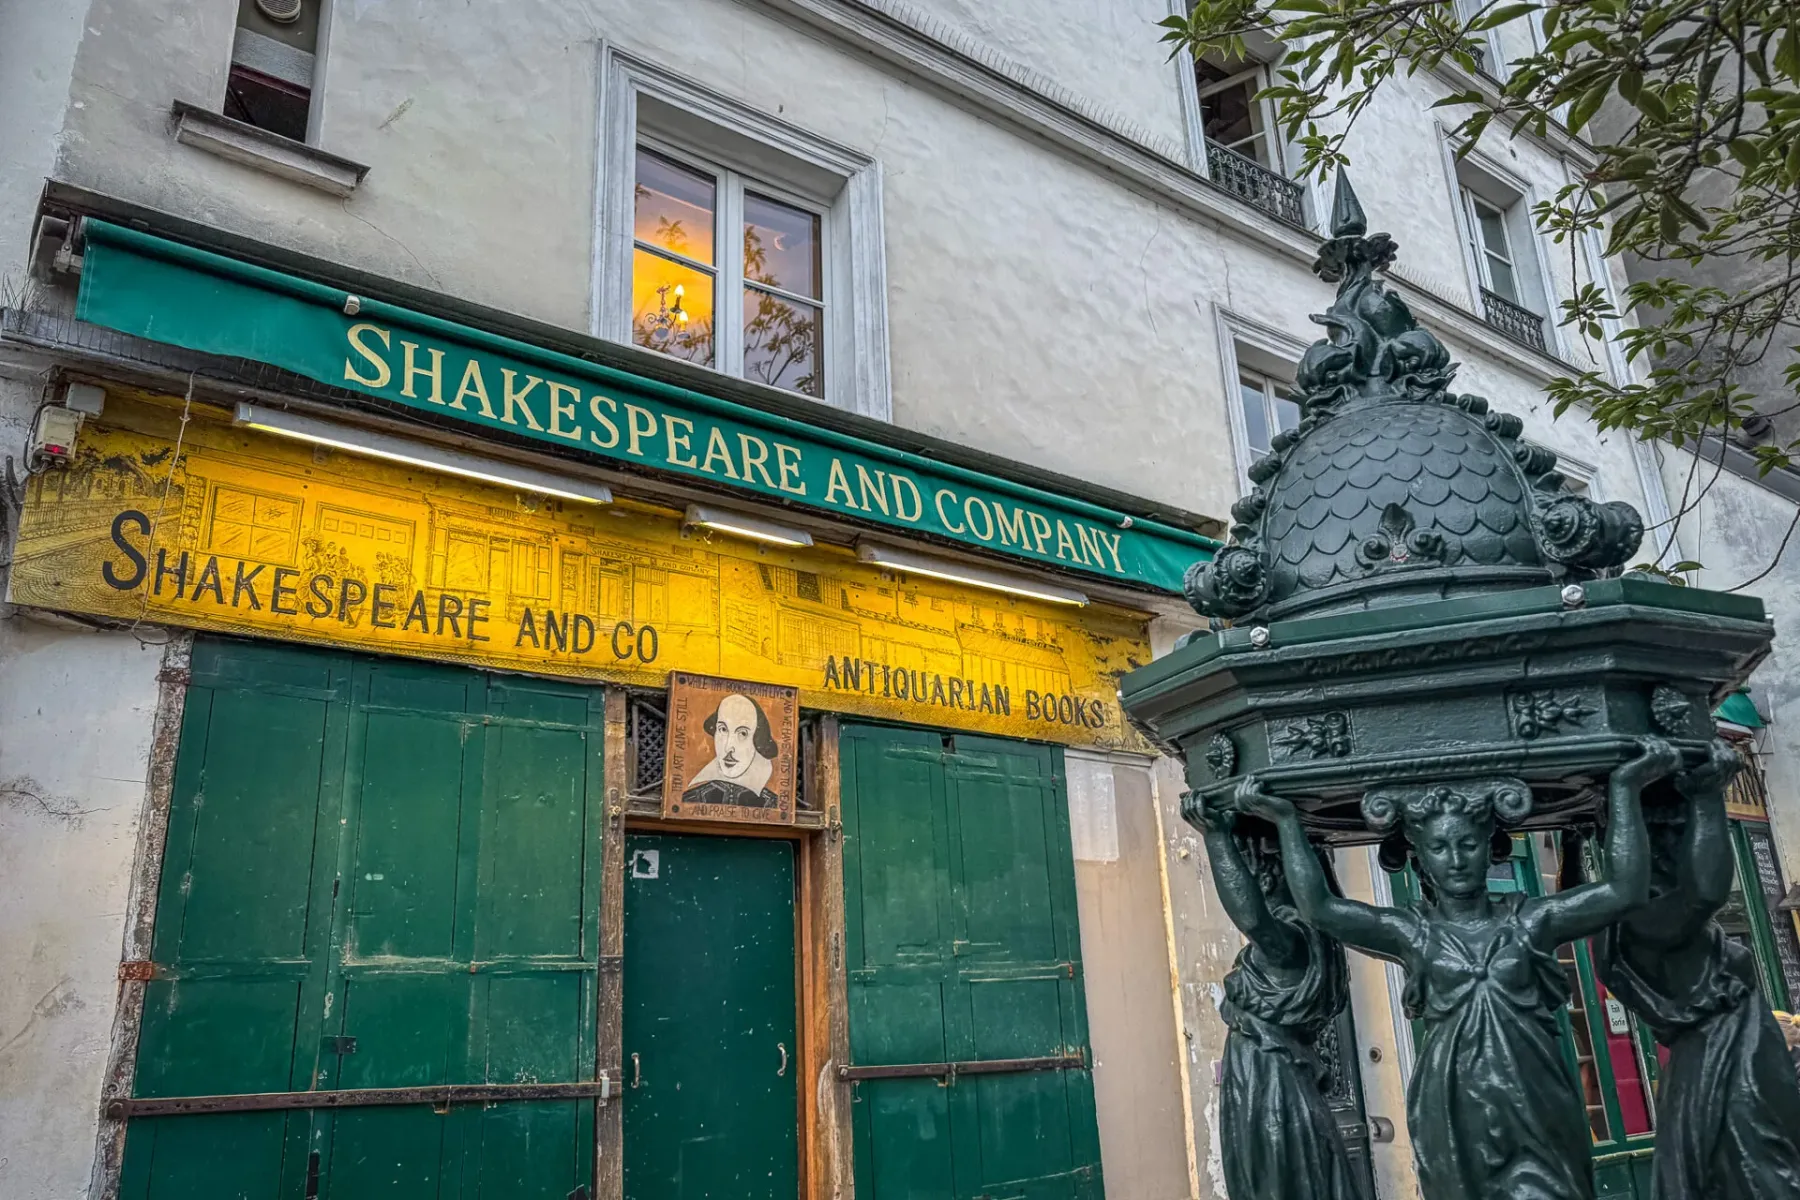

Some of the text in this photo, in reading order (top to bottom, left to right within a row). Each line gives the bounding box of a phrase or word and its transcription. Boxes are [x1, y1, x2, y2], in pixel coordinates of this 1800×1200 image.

[344, 323, 1126, 573] SHAKESPEARE AND COMPANY
[102, 509, 491, 642] SHAKESPEARE
[515, 607, 595, 653] AND
[611, 621, 659, 663] CO
[783, 699, 792, 714] AND
[823, 655, 1105, 729] ANTIQUARIAN BOOKS
[671, 697, 688, 792] THOU ART ALIVE STILL
[692, 804, 771, 820] AND PRAISE TO GIVE
[780, 778, 790, 787] TO
